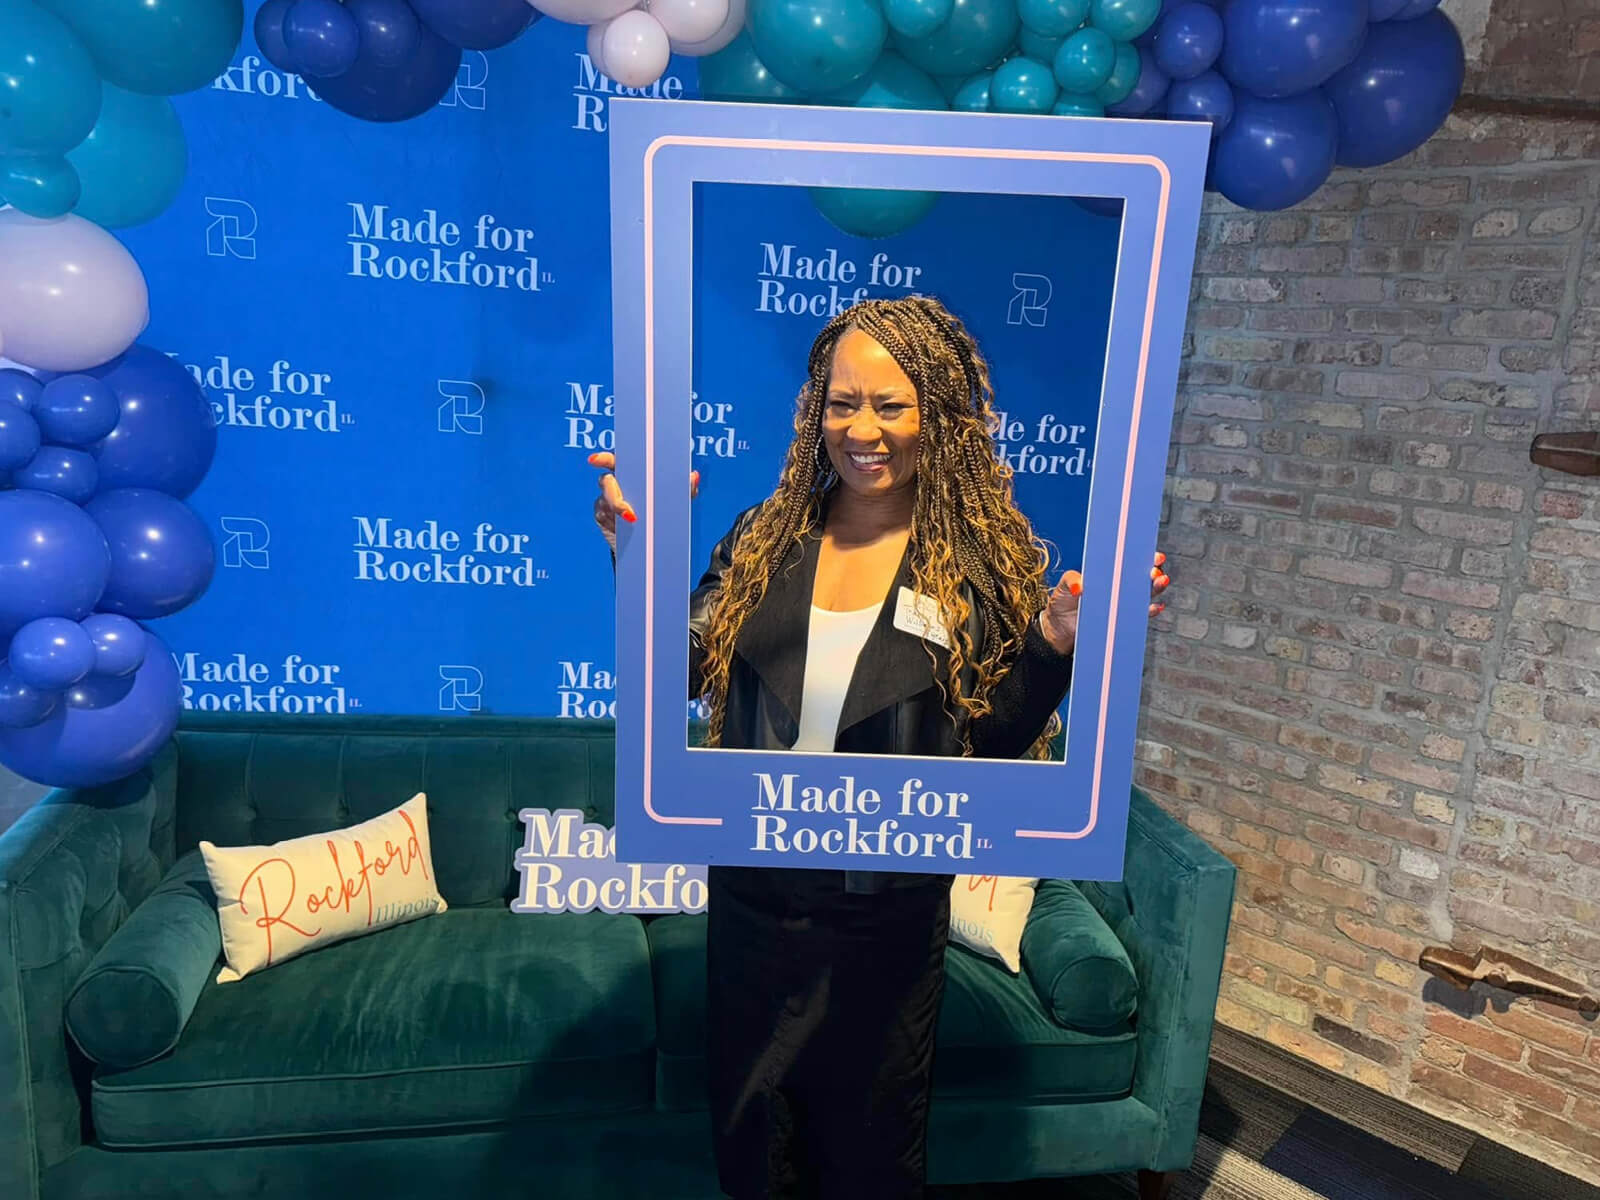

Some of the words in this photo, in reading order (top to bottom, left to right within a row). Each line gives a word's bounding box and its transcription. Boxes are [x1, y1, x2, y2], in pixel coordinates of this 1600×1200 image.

[211, 56, 322, 101] kfor
[347, 202, 460, 246] Made
[474, 215, 535, 252] for
[347, 241, 541, 291] Rockford
[758, 243, 856, 283] Made
[868, 253, 922, 288] for
[269, 360, 331, 396] for
[209, 393, 341, 432] ckford
[691, 391, 733, 424] or
[1035, 414, 1085, 444] for
[998, 444, 1086, 475] kford
[353, 516, 460, 551] Made
[473, 523, 530, 554] for
[353, 550, 536, 586] Rockford
[282, 655, 340, 684] for
[752, 773, 881, 815] Made
[898, 779, 969, 818] for
[750, 815, 975, 859] Rockford
[976, 838, 993, 849] IL
[240, 810, 429, 965] Rockford
[517, 863, 709, 909] Rockfo
